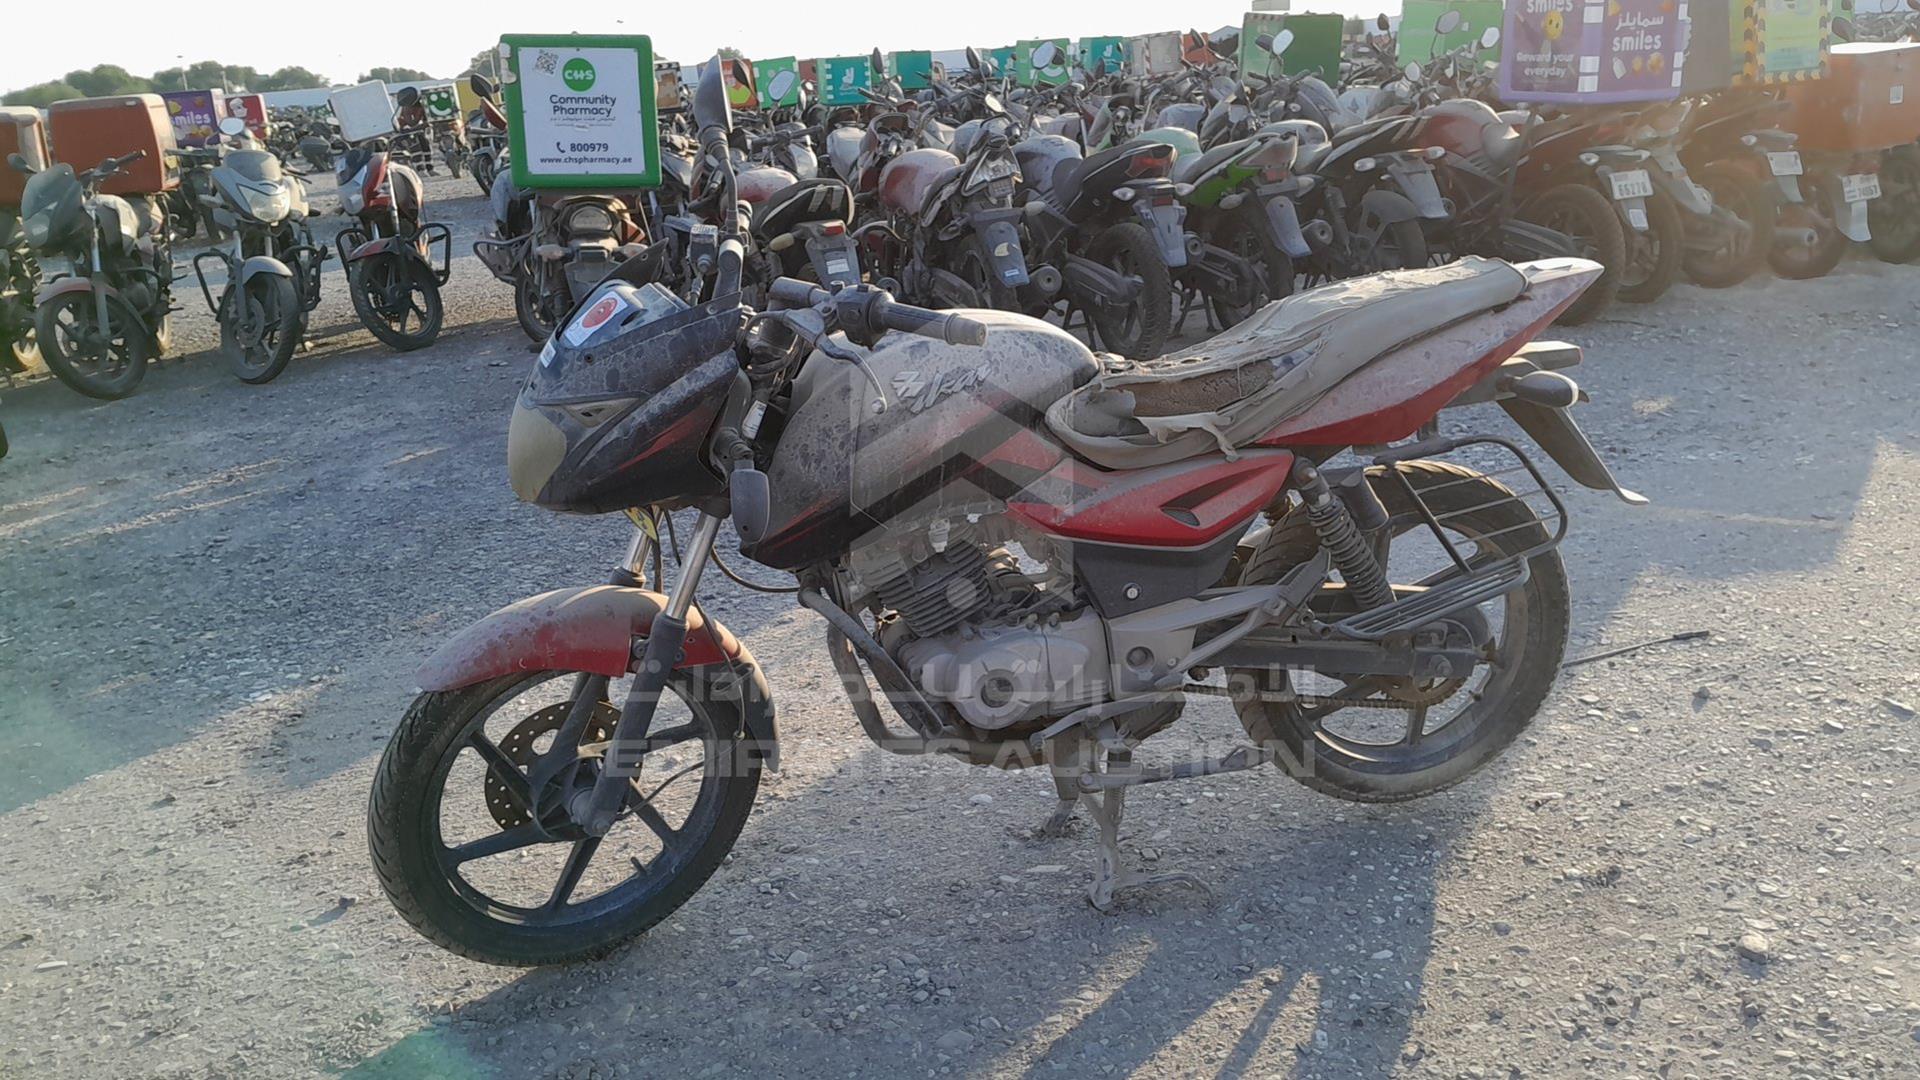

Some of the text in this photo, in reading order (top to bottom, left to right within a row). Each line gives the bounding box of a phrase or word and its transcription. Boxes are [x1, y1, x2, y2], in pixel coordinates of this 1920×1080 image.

[1612, 31, 1662, 52] smiles
[1524, 66, 1567, 79] everyday
[549, 94, 616, 107] Community
[552, 105, 612, 117] Pharmacy
[570, 143, 609, 152] 800979
[540, 156, 633, 165] www.chspharmacy.ae
